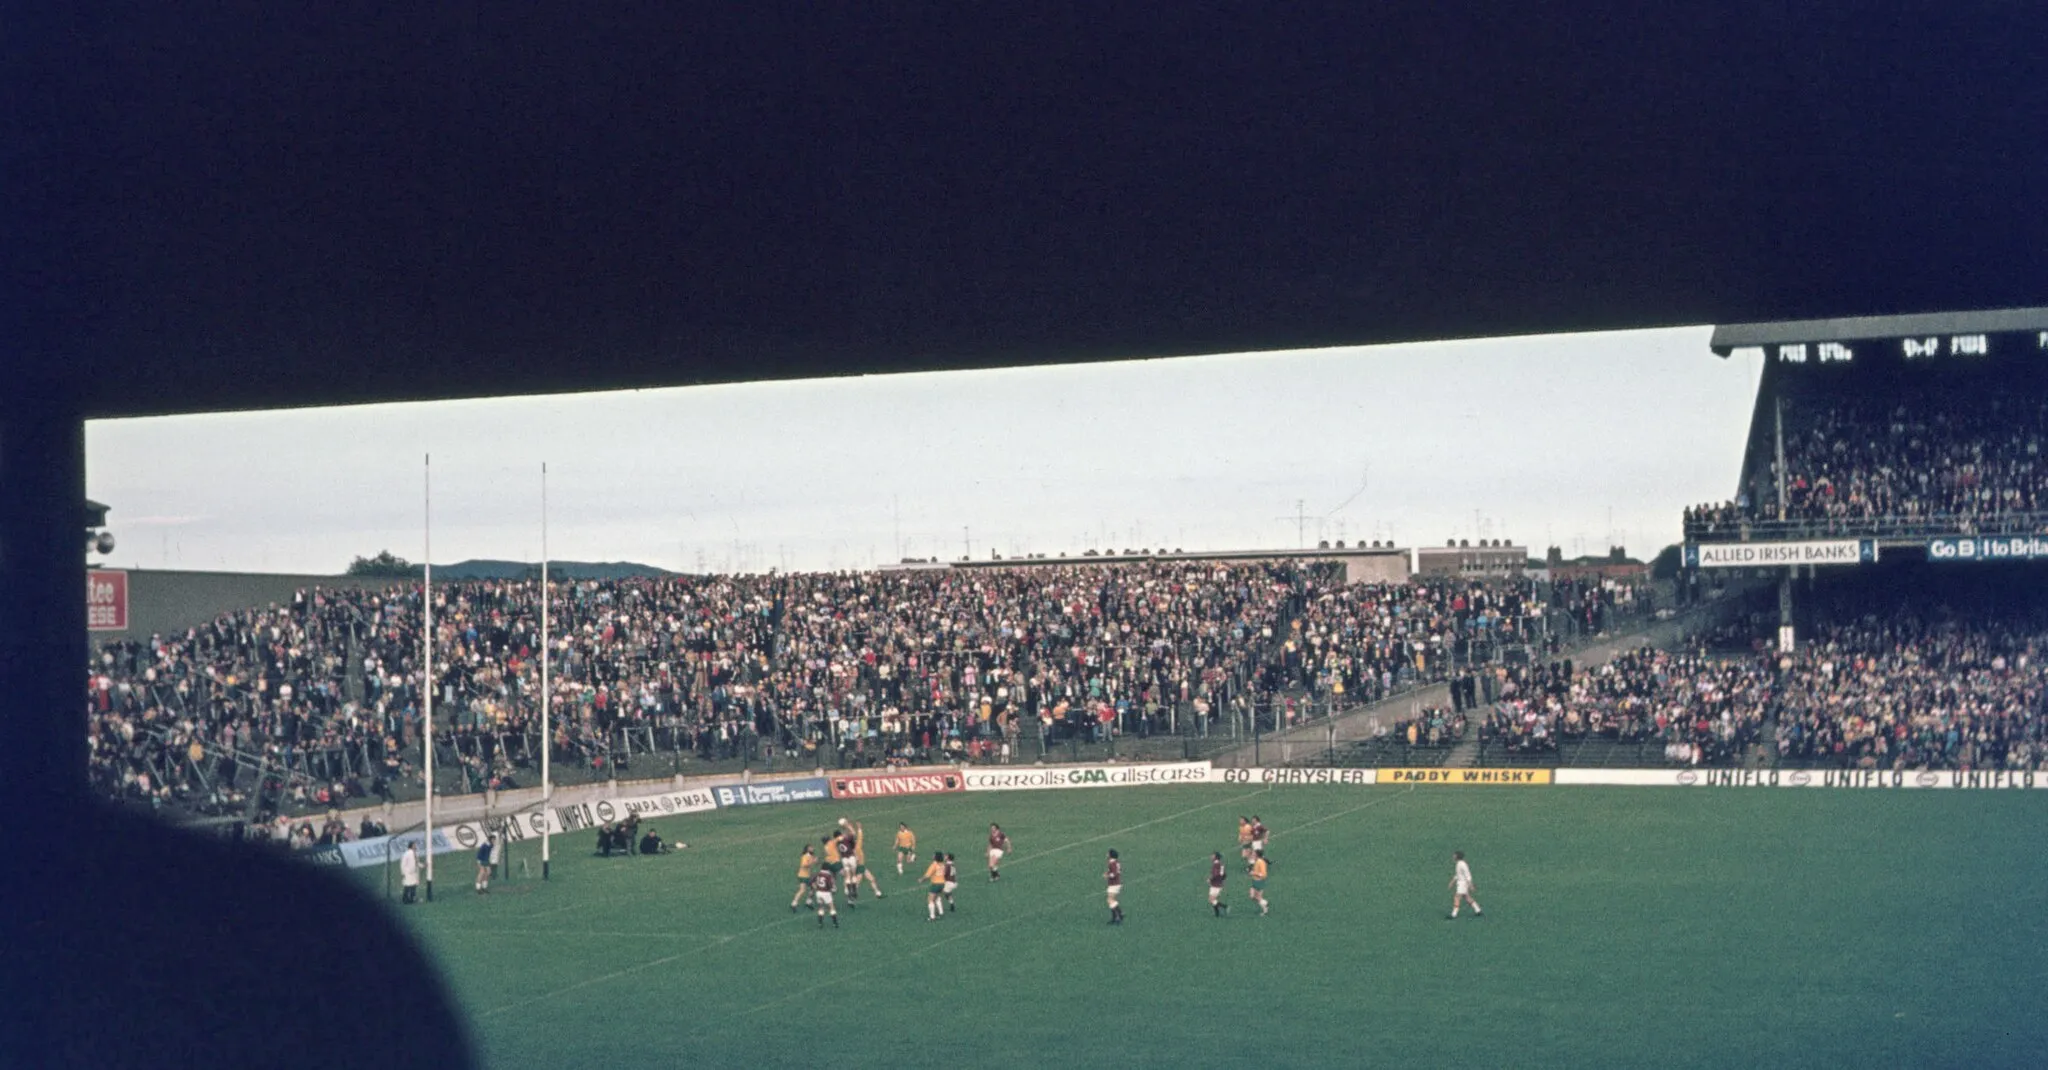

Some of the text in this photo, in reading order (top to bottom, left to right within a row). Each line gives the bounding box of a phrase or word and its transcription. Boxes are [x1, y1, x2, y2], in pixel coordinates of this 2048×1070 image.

[1703, 544, 1856, 562] ALLIED IRISH BANKS
[1931, 540, 1956, 557] Go
[1992, 540, 2009, 556] to
[848, 775, 943, 794] GUINNESS
[1068, 769, 1107, 784] GAA
[1224, 768, 1364, 784] GO CHRYSLER
[1393, 770, 1534, 782] PADDY WHISKY
[1707, 770, 1778, 786] UNIFLO
[1825, 770, 1902, 787] UNIFLO
[1952, 771, 2034, 787] UNIFLO
[555, 803, 594, 832] UNIFLO
